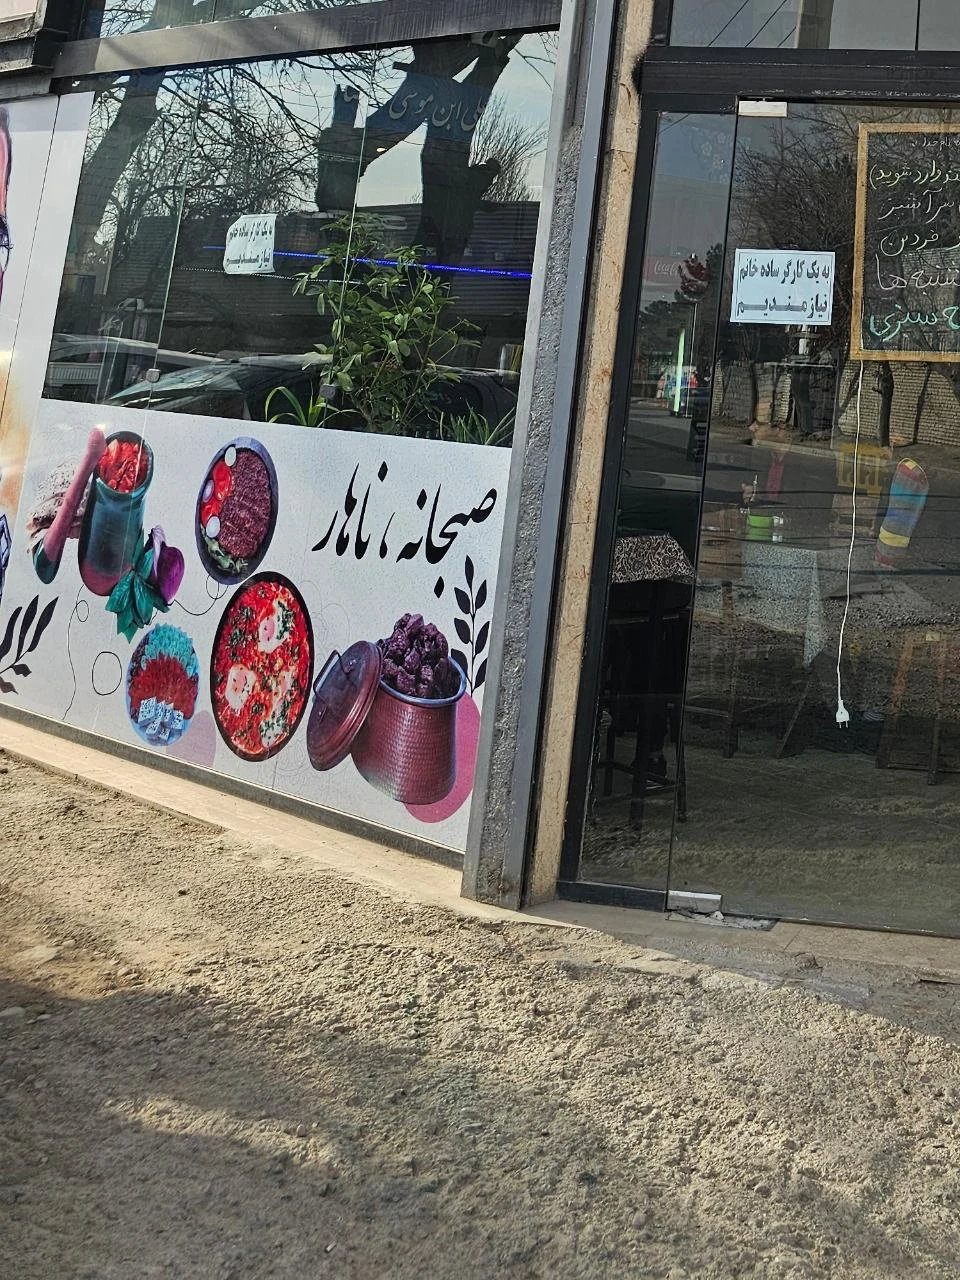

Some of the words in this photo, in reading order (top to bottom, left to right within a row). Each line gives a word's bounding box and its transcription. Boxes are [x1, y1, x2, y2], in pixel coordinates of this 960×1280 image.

[912, 159, 942, 185] وارد
[880, 229, 939, 257] فردین
[739, 257, 759, 283] خانم
[760, 258, 780, 278] ساده
[780, 258, 805, 284] کارگر
[806, 259, 820, 283] یک
[821, 264, 830, 284] به
[875, 253, 908, 290] ها
[736, 293, 828, 319] نیازمندیم
[869, 304, 938, 342] سبزی
[312, 461, 391, 559] ناهار
